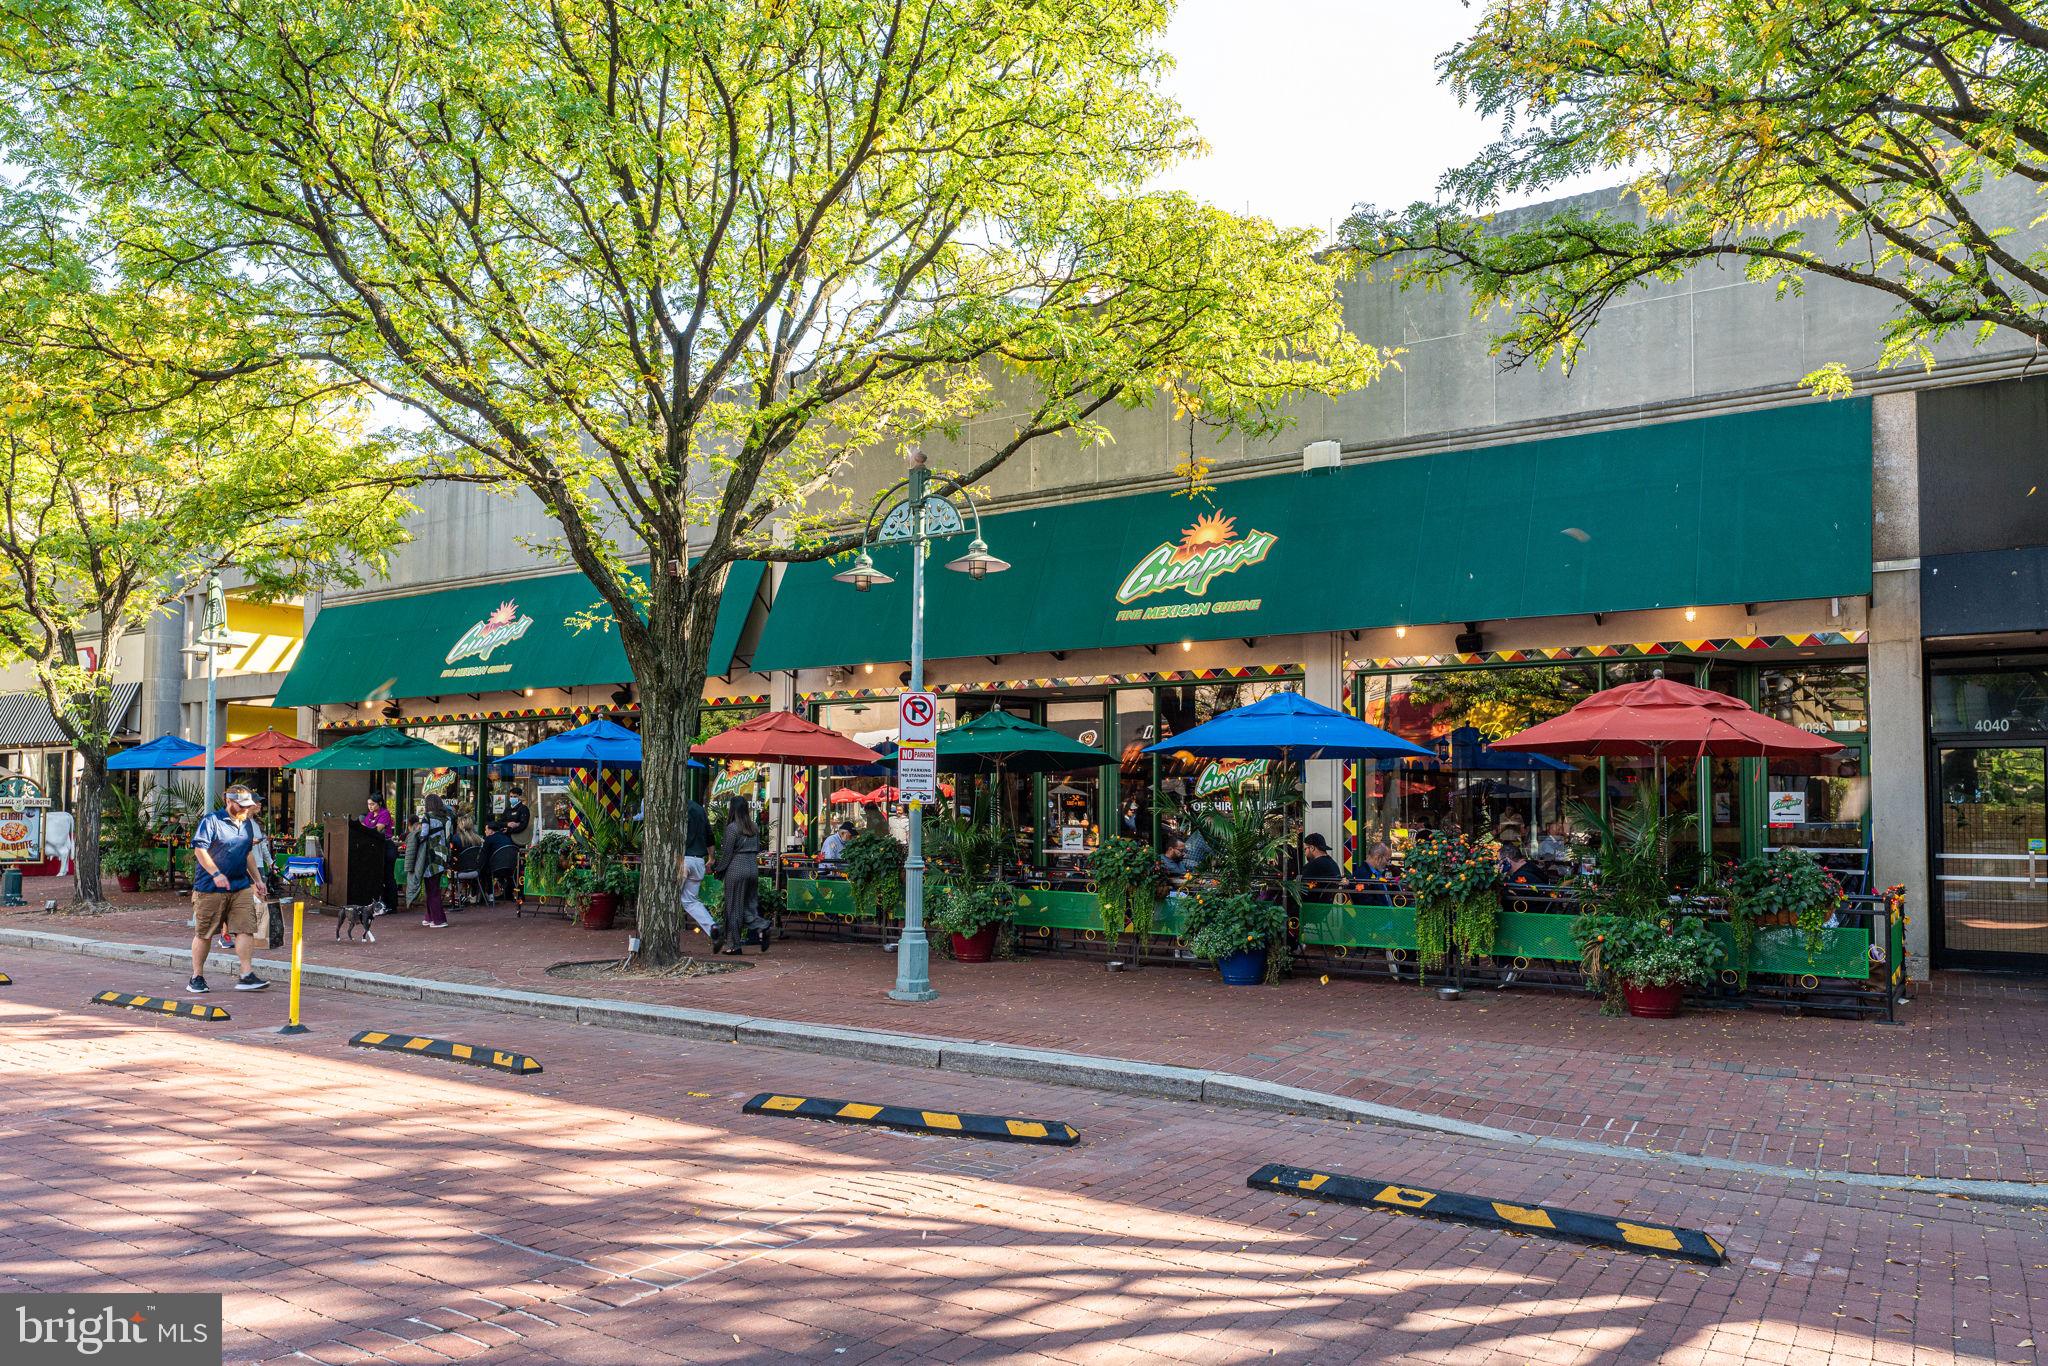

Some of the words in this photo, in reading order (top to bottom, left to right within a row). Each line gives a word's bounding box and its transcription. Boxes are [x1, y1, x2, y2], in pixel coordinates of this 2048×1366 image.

[1117, 532, 1272, 602] Guapo's
[1115, 609, 1144, 622] FINE
[1142, 602, 1211, 620] MEXICAN
[1211, 599, 1262, 613] CUISINE
[1974, 719, 2010, 732] 4040
[902, 749, 913, 760] NO
[914, 751, 934, 759] PARKING
